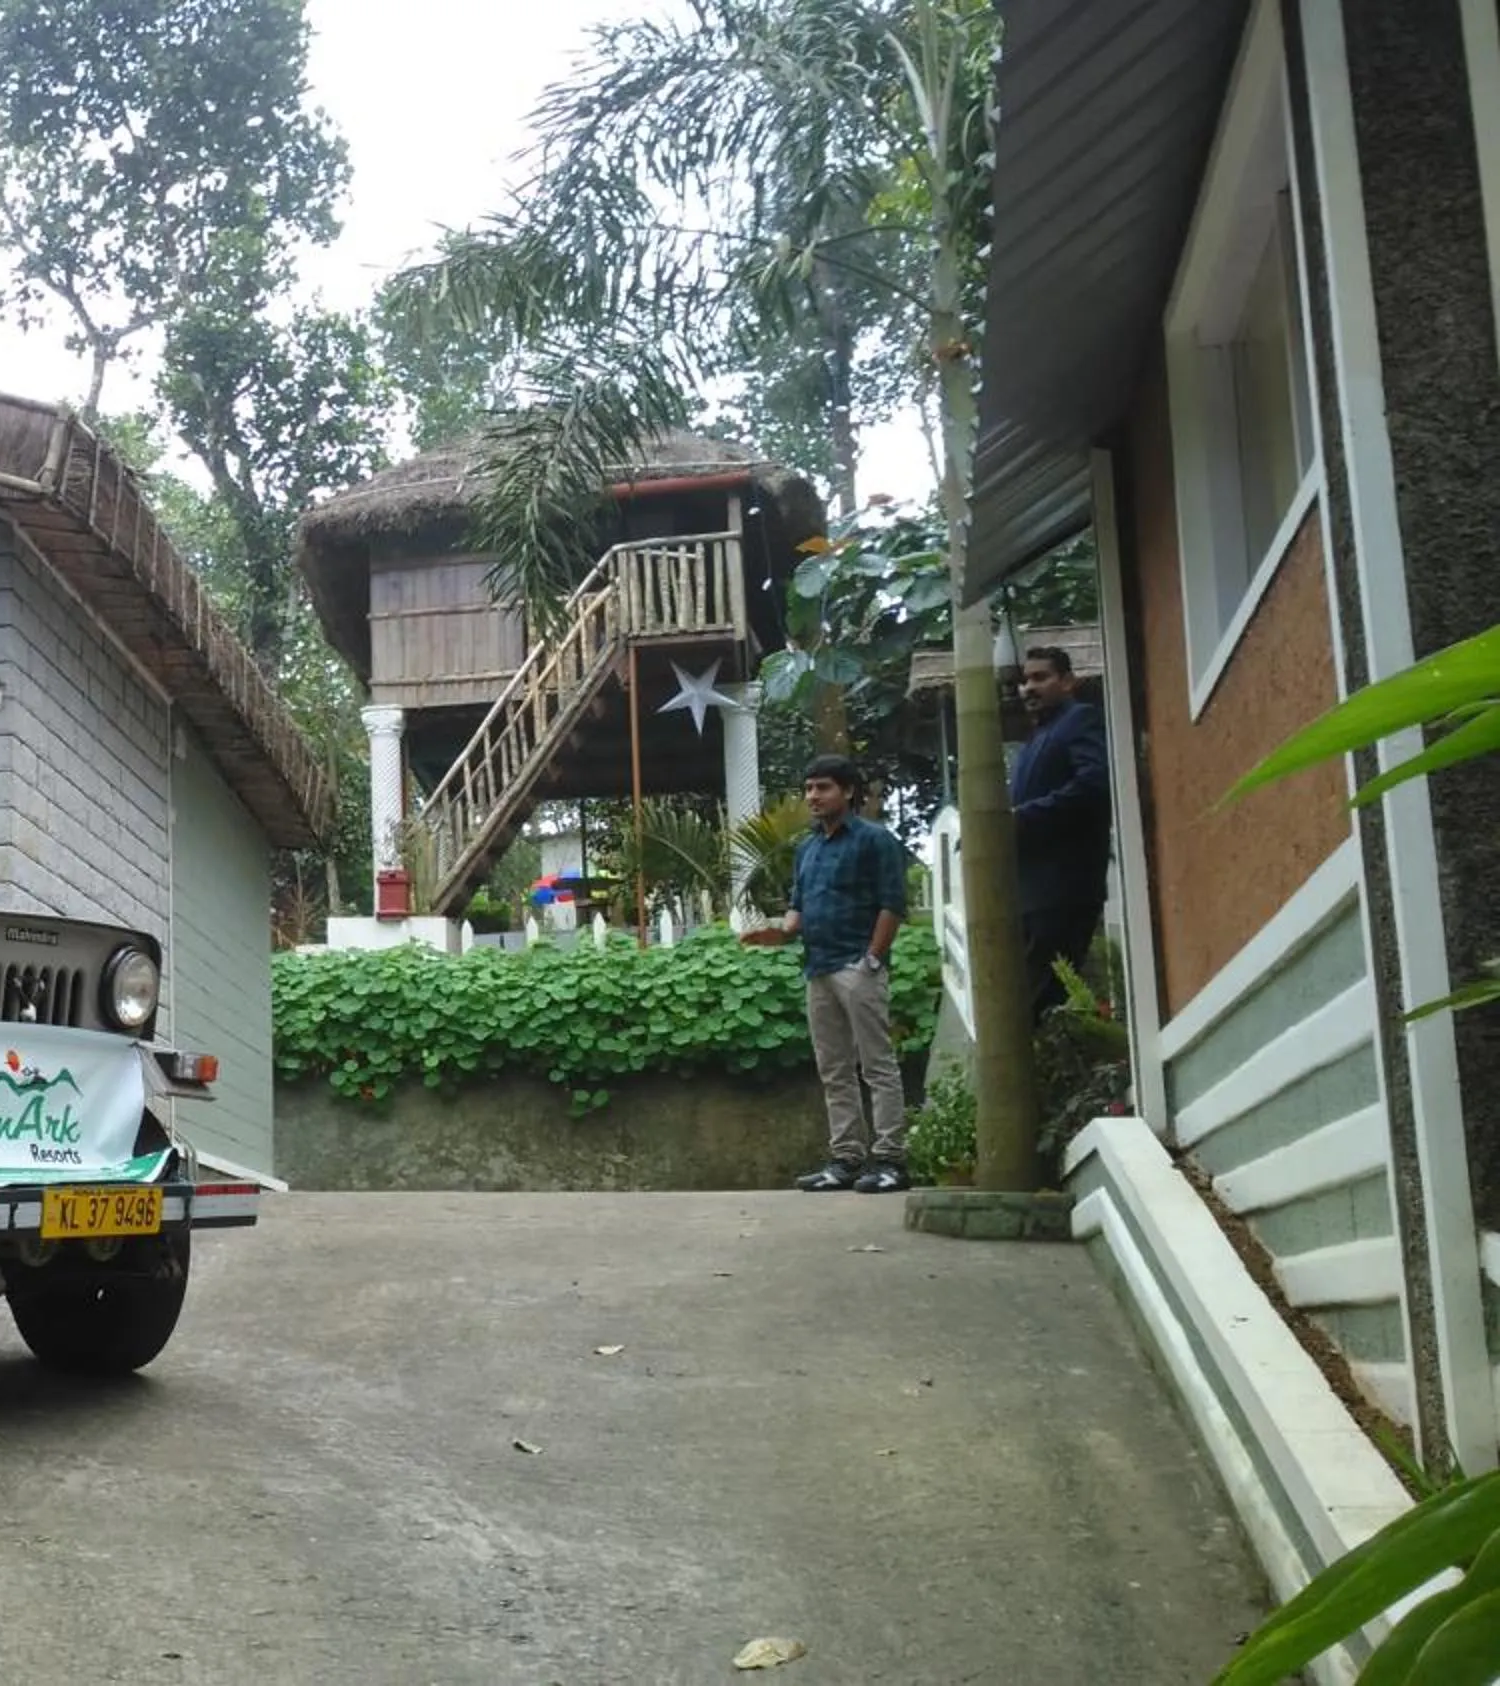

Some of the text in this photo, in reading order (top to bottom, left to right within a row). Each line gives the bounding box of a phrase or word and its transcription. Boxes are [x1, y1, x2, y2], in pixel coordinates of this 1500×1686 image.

[29, 1142, 83, 1165] Resorts
[59, 1194, 157, 1230] KL 37 9496
